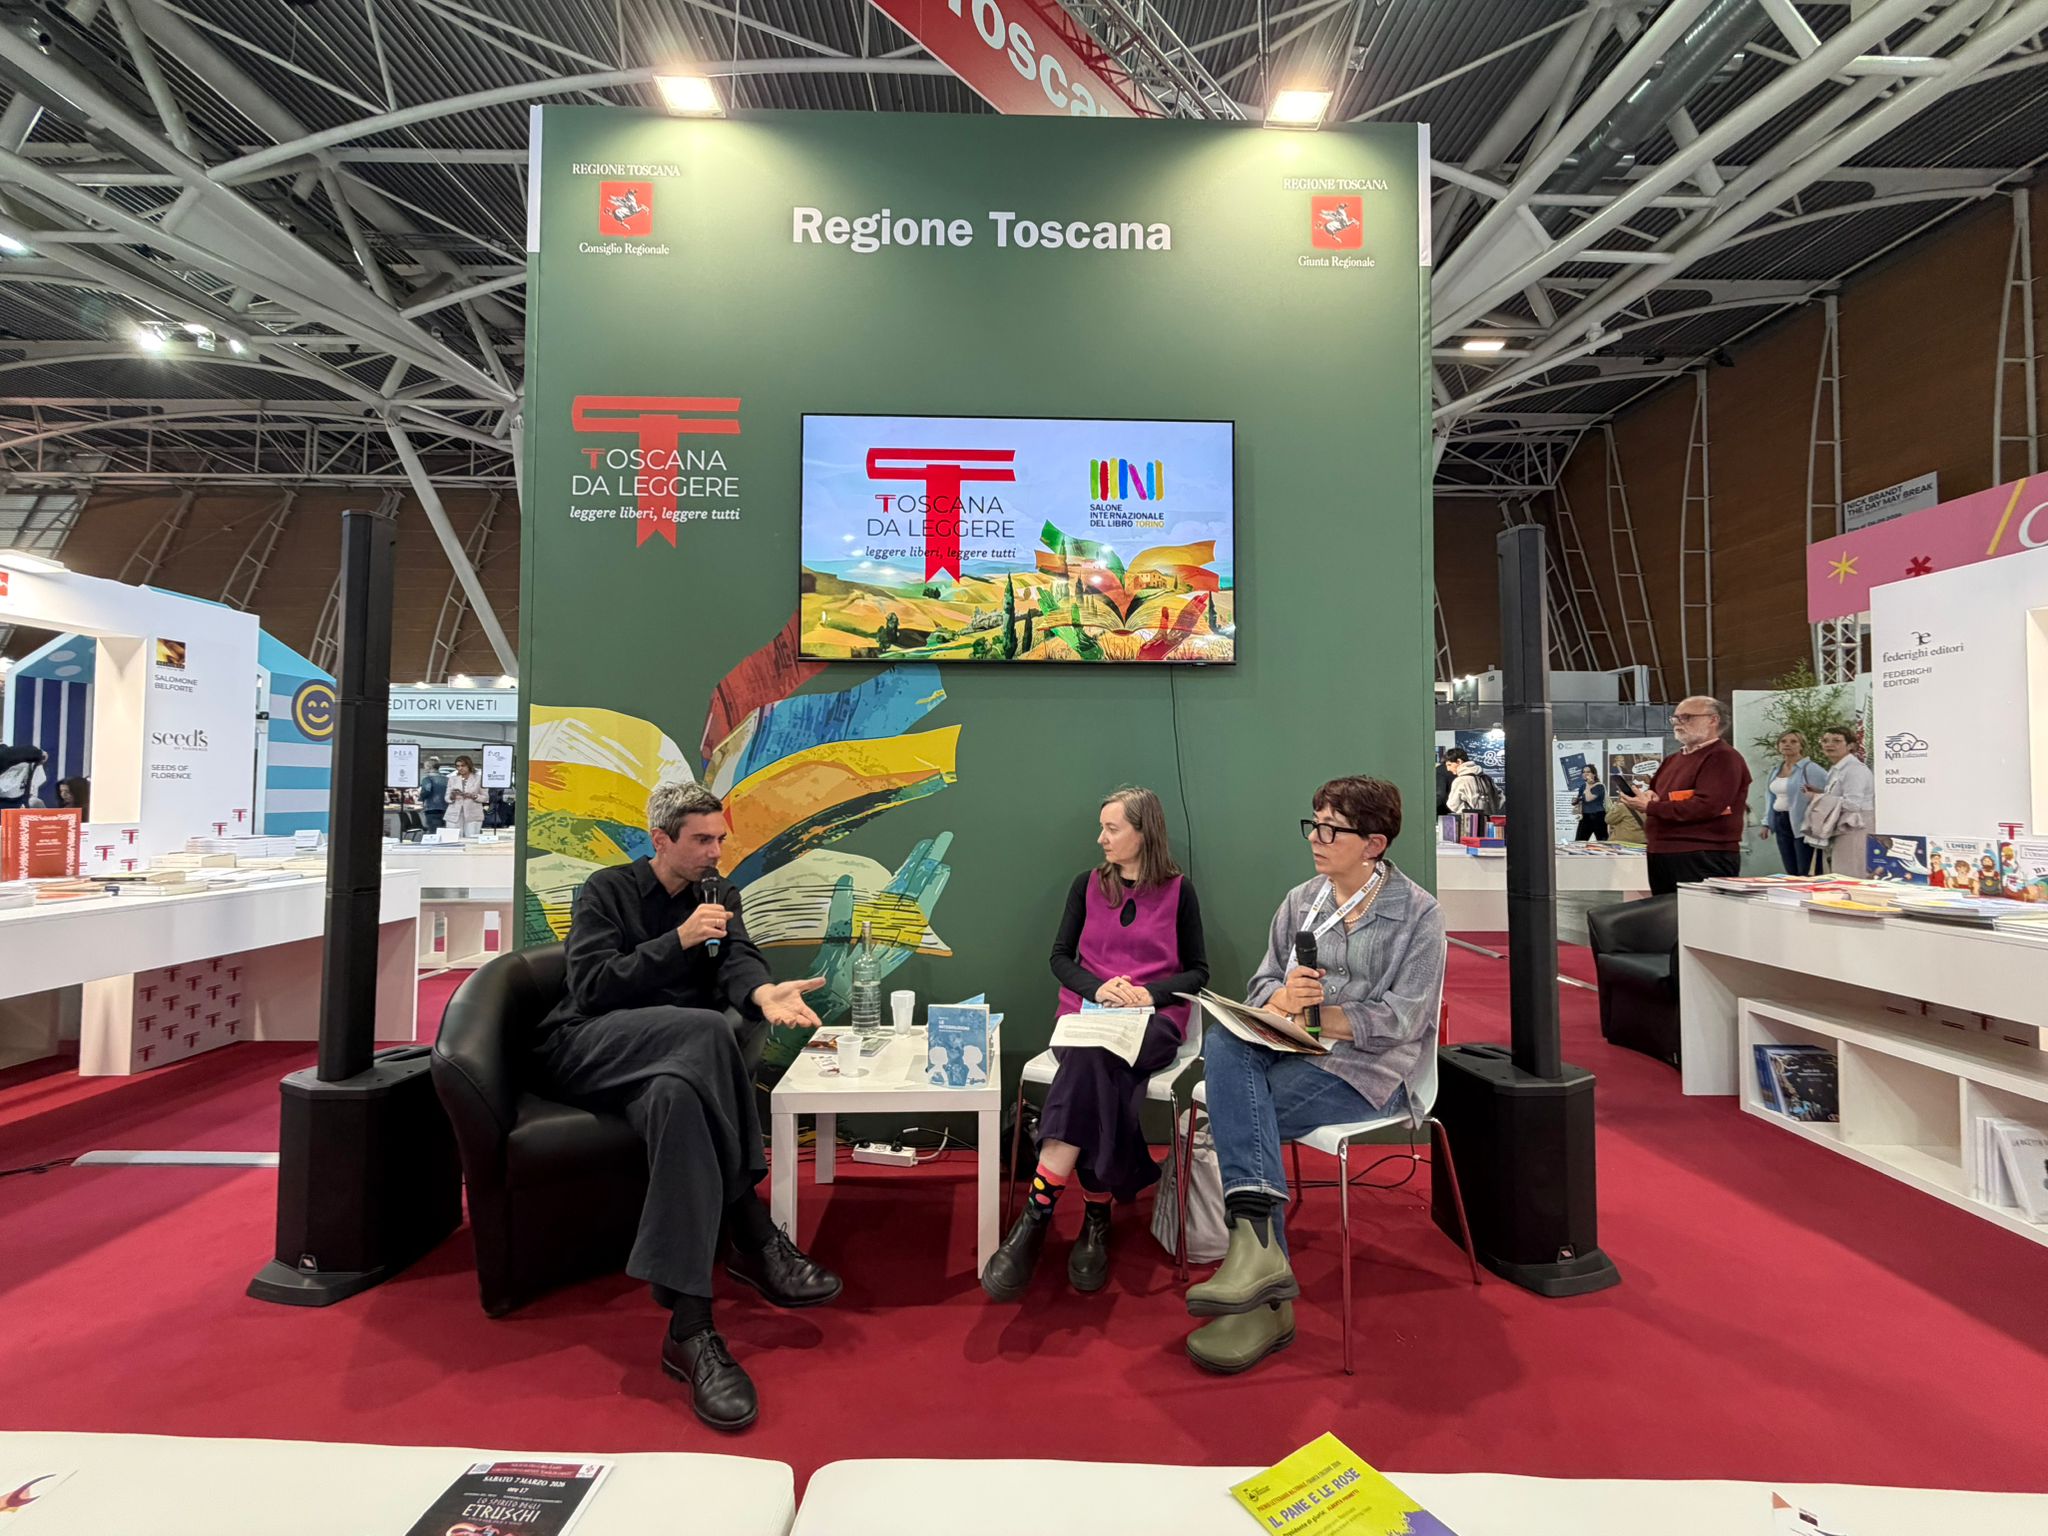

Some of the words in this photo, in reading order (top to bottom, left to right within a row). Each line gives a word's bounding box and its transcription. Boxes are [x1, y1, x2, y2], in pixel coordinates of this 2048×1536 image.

[572, 163, 626, 176] REGIONE
[627, 164, 681, 177] TOSCANA
[1283, 178, 1336, 190] REGIONE
[1336, 179, 1389, 190] TOSCANA
[792, 206, 974, 254] Regione
[988, 210, 1172, 251] Toscana
[579, 242, 622, 256] Consiglio
[624, 242, 670, 256] Regionale
[1298, 255, 1329, 267] Giunta
[1331, 256, 1375, 269] Regionale
[581, 448, 728, 471] TOSCANA
[572, 475, 611, 496] DA
[619, 476, 740, 497] LEGGERE
[875, 494, 1004, 514] TOSCANA
[1847, 497, 1866, 509] NICK
[1868, 485, 1904, 501] BRANDT
[1847, 507, 1864, 516] THE
[1865, 500, 1882, 511] DAY
[1883, 493, 1901, 504] MAY
[1903, 482, 1934, 498] BREAK
[569, 505, 617, 522] leggere
[620, 506, 658, 521] liberi,
[661, 507, 708, 523] leggere
[711, 508, 741, 520] tutti
[1089, 504, 1123, 512] SALONE
[1090, 512, 1165, 520] INTERNAZIONALE
[867, 518, 900, 537] DA
[909, 519, 1015, 538] LEGGERE
[1108, 520, 1134, 528] LIBRO
[865, 546, 906, 560] leggere
[909, 546, 944, 560] liberi,
[947, 547, 988, 561] leggere
[991, 548, 1017, 559] tutti
[1882, 650, 1929, 663] federighi
[1930, 643, 1964, 656] editori
[154, 674, 198, 686] SALOMONE
[1883, 667, 1933, 679] FEDERIGHI
[154, 682, 193, 692] BELFORTE
[1883, 678, 1920, 688] EDITORI
[445, 699, 497, 710] VENETI
[519, 1478, 548, 1486] MARZO
[488, 1498, 518, 1507] SPIRITO
[518, 1501, 542, 1510] DEGLI
[1267, 1515, 1284, 1529] IL
[1280, 1498, 1312, 1522] PANE
[1307, 1492, 1321, 1505] E
[1316, 1484, 1335, 1499] LE
[1331, 1467, 1361, 1490] ROSE
[462, 1503, 541, 1523] ETRUSCHI
